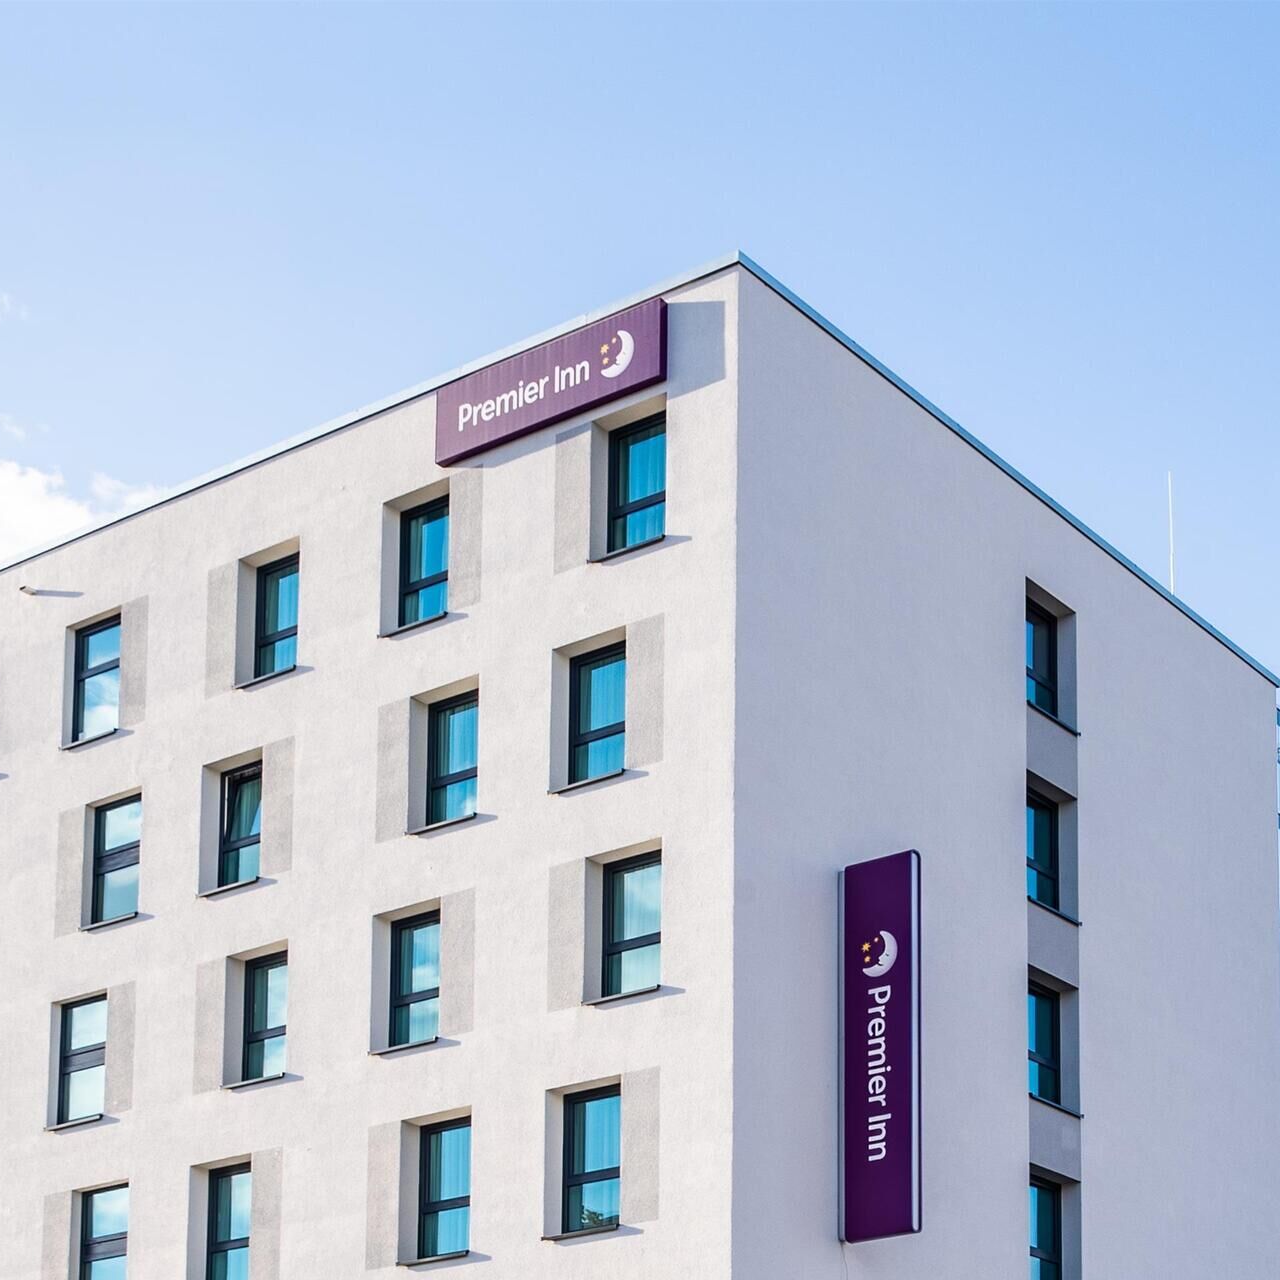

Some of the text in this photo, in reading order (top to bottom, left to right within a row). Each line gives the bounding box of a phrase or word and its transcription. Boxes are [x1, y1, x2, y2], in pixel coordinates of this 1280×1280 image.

[457, 359, 590, 431] Premier Inn
[867, 984, 892, 1162] Premier Inn
